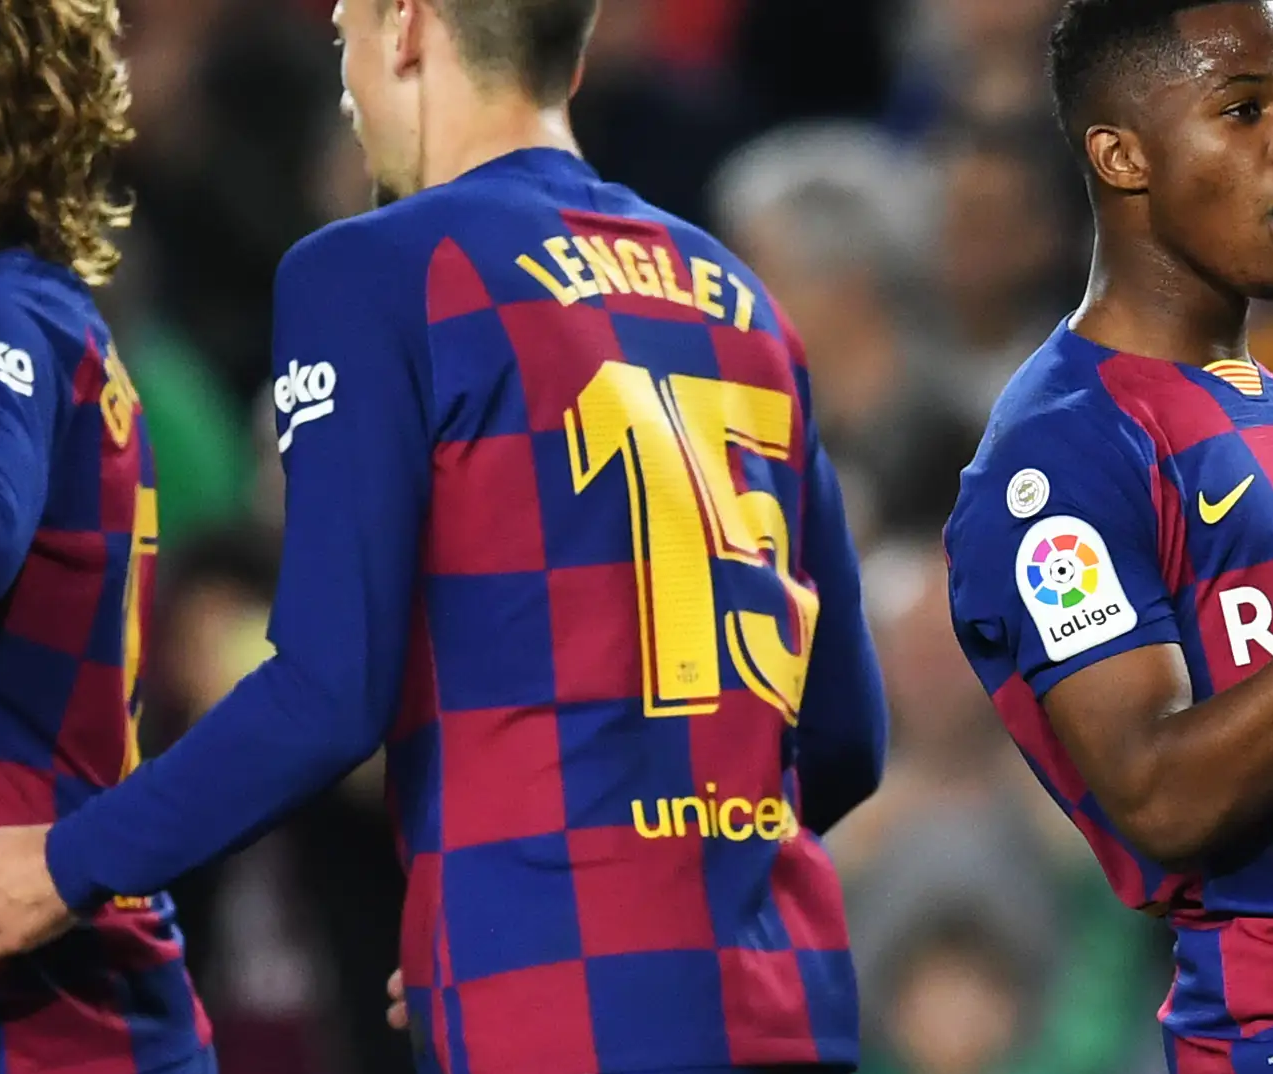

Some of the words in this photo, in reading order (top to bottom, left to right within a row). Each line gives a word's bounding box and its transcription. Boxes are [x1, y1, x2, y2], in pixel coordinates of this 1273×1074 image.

[515, 235, 756, 333] LENGLET
[563, 359, 820, 727] 15
[1049, 603, 1121, 643] LaLiga
[630, 782, 800, 844] unice
